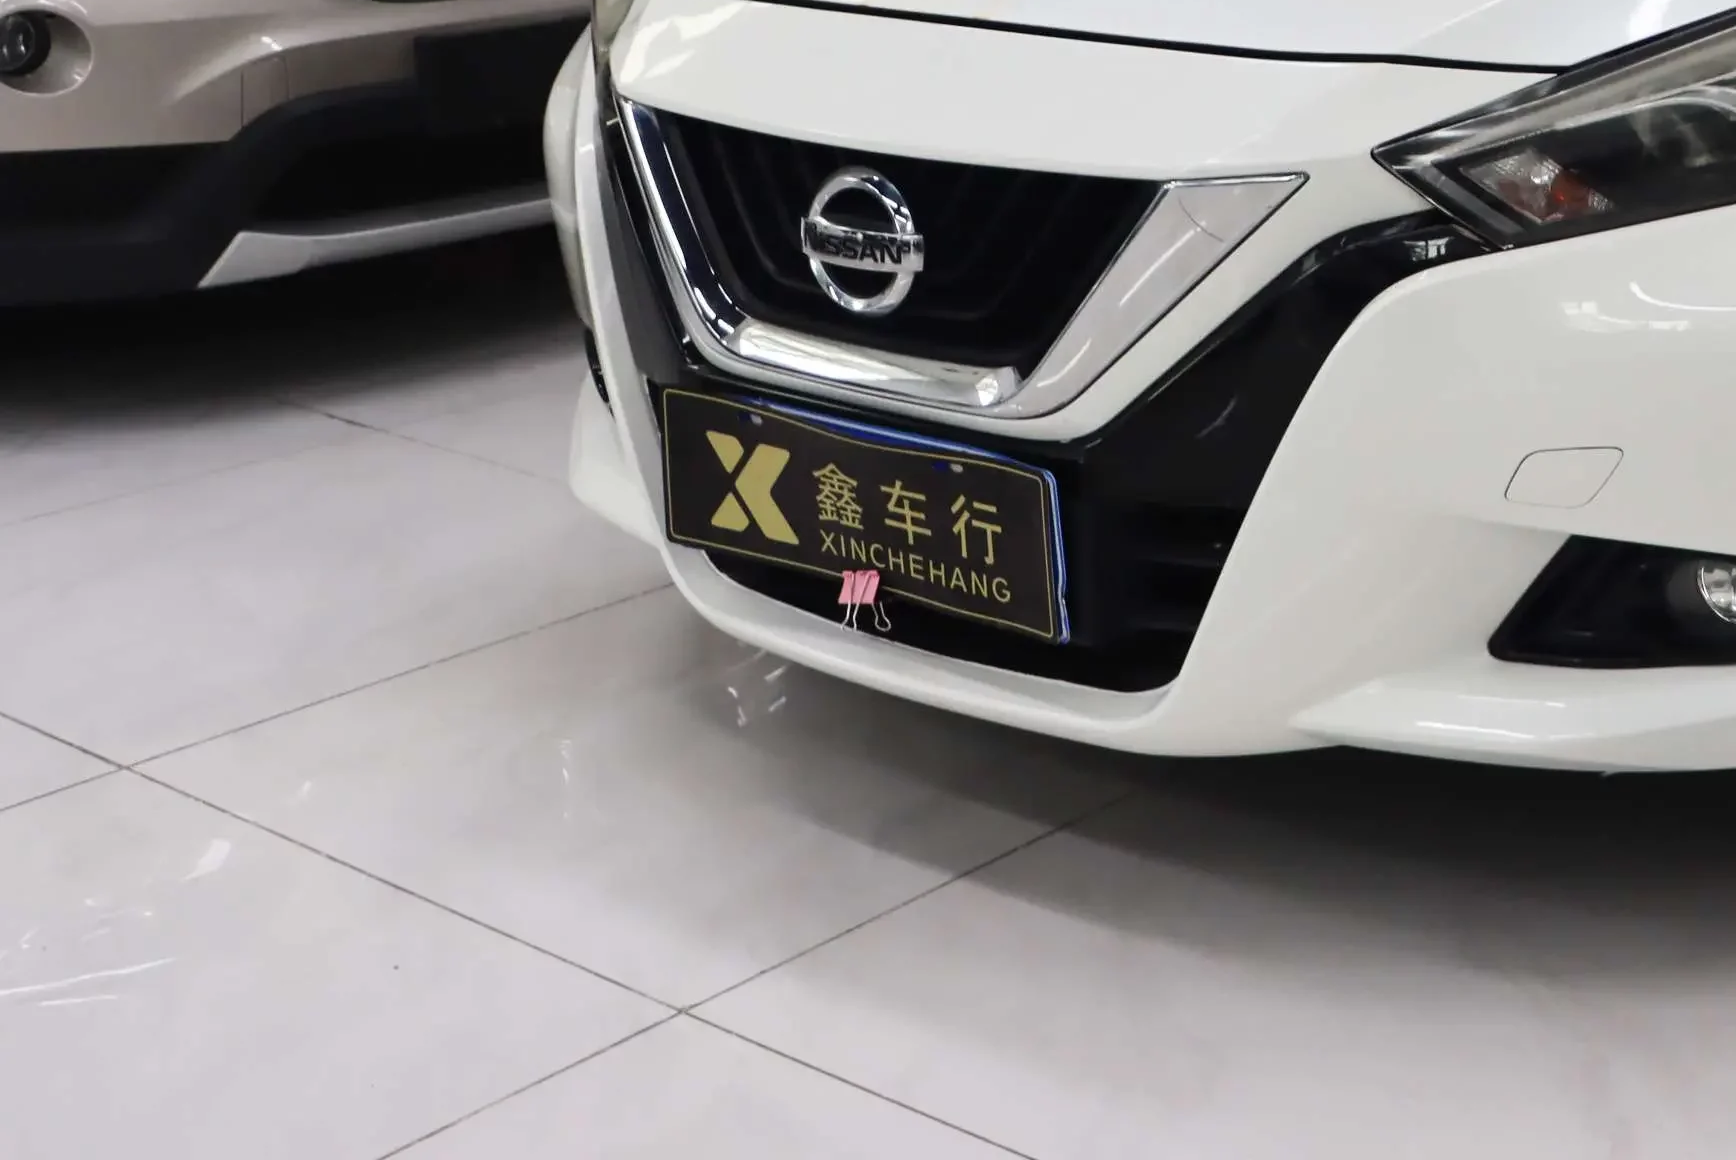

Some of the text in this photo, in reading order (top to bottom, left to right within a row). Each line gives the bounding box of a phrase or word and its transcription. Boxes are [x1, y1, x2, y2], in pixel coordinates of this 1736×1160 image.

[812, 463, 1003, 566] 鑫车行
[820, 529, 1012, 604] XINCHEHANG
